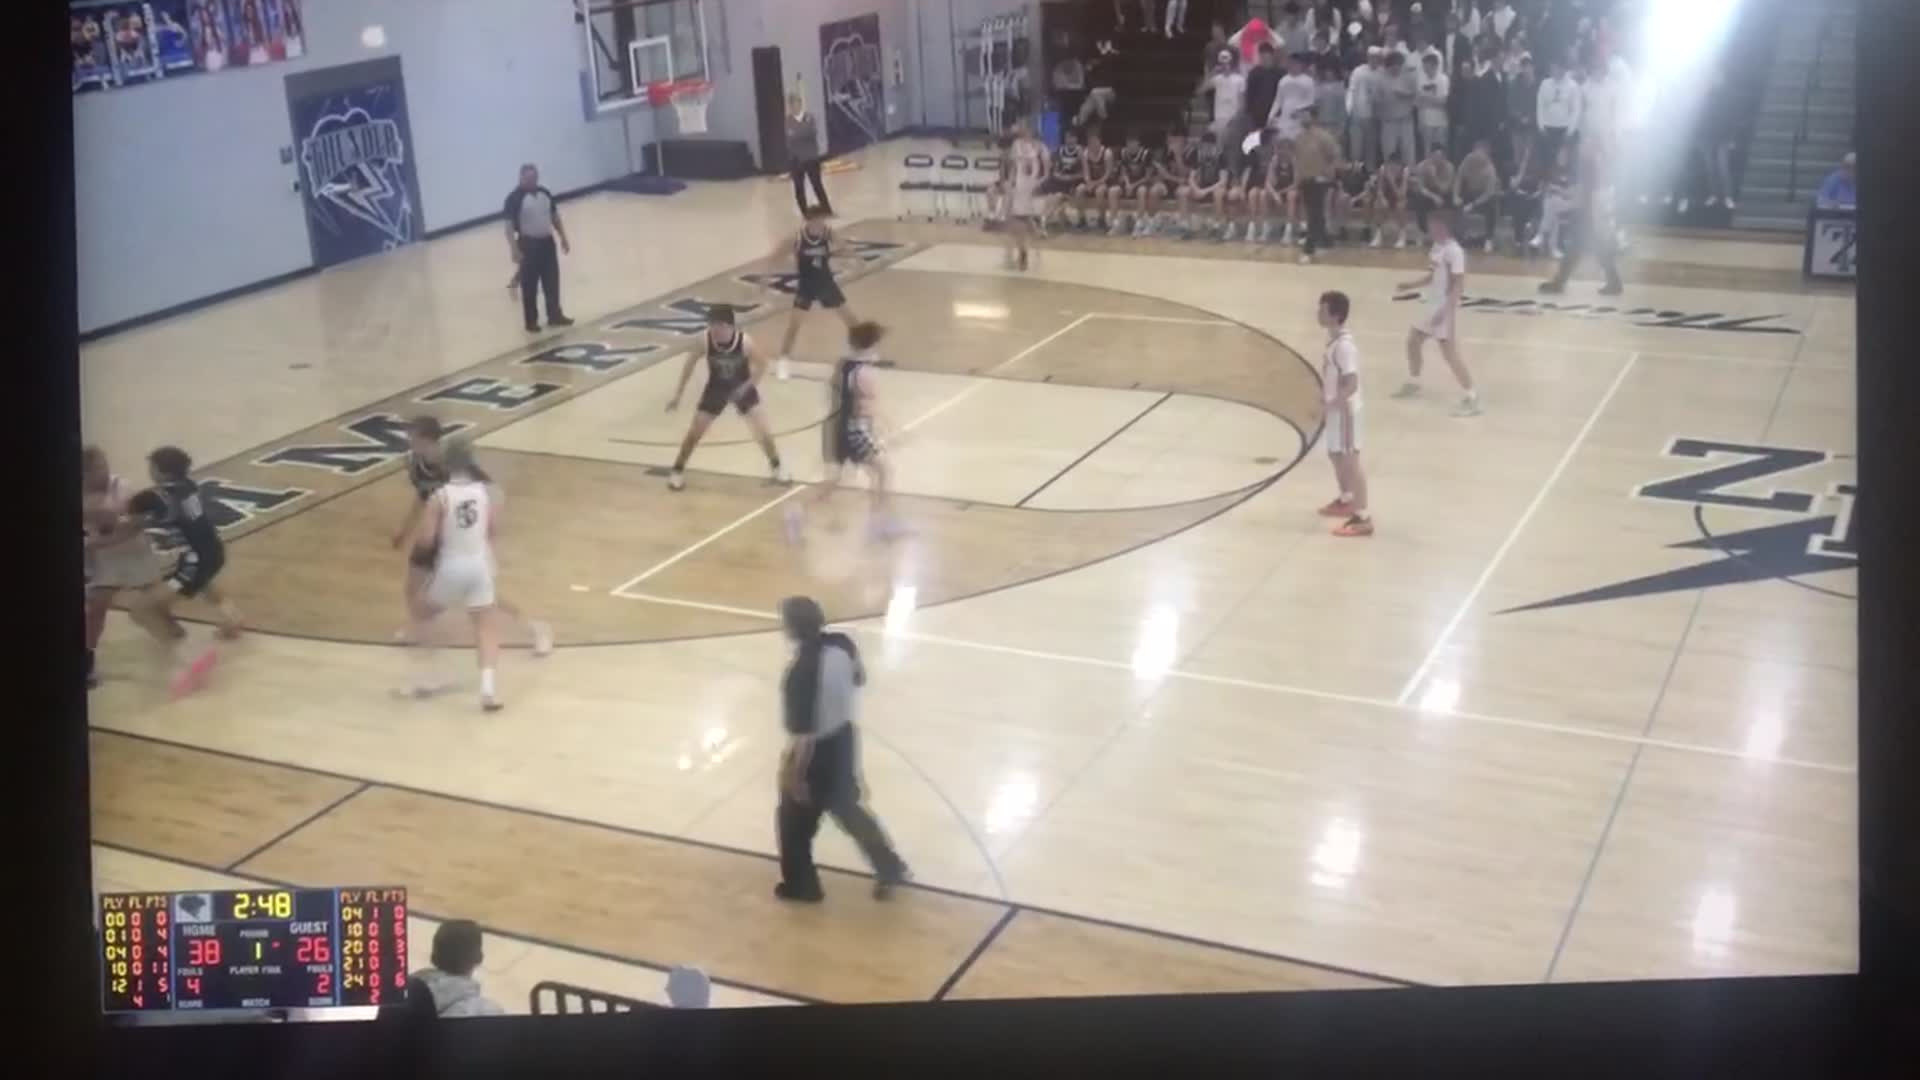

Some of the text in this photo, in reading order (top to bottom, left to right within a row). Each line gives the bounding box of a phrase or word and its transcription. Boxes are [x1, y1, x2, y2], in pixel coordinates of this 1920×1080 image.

[234, 891, 291, 919] 2:48
[342, 906, 362, 921] 04
[394, 905, 405, 920] 0
[106, 911, 167, 927] 00 0 0
[106, 927, 168, 943] 01 0 4
[183, 924, 216, 936] HOME
[289, 921, 329, 934] GUEST
[347, 922, 363, 937] 10
[368, 922, 379, 937] 0
[106, 944, 168, 960] 04 0 4
[188, 939, 221, 965] 38
[255, 941, 262, 960] 1
[297, 937, 331, 962] 26
[343, 939, 363, 955] 20
[368, 939, 379, 954] 0
[112, 961, 168, 976] 10 0 11
[343, 956, 364, 971] 21
[369, 956, 380, 971] 0
[112, 978, 128, 993] 12
[158, 977, 168, 992] 5
[186, 977, 200, 994] 4
[317, 973, 331, 994] 2
[343, 971, 406, 988] 24 0 6
[132, 995, 143, 1008] 4
[370, 988, 381, 1004] 2
